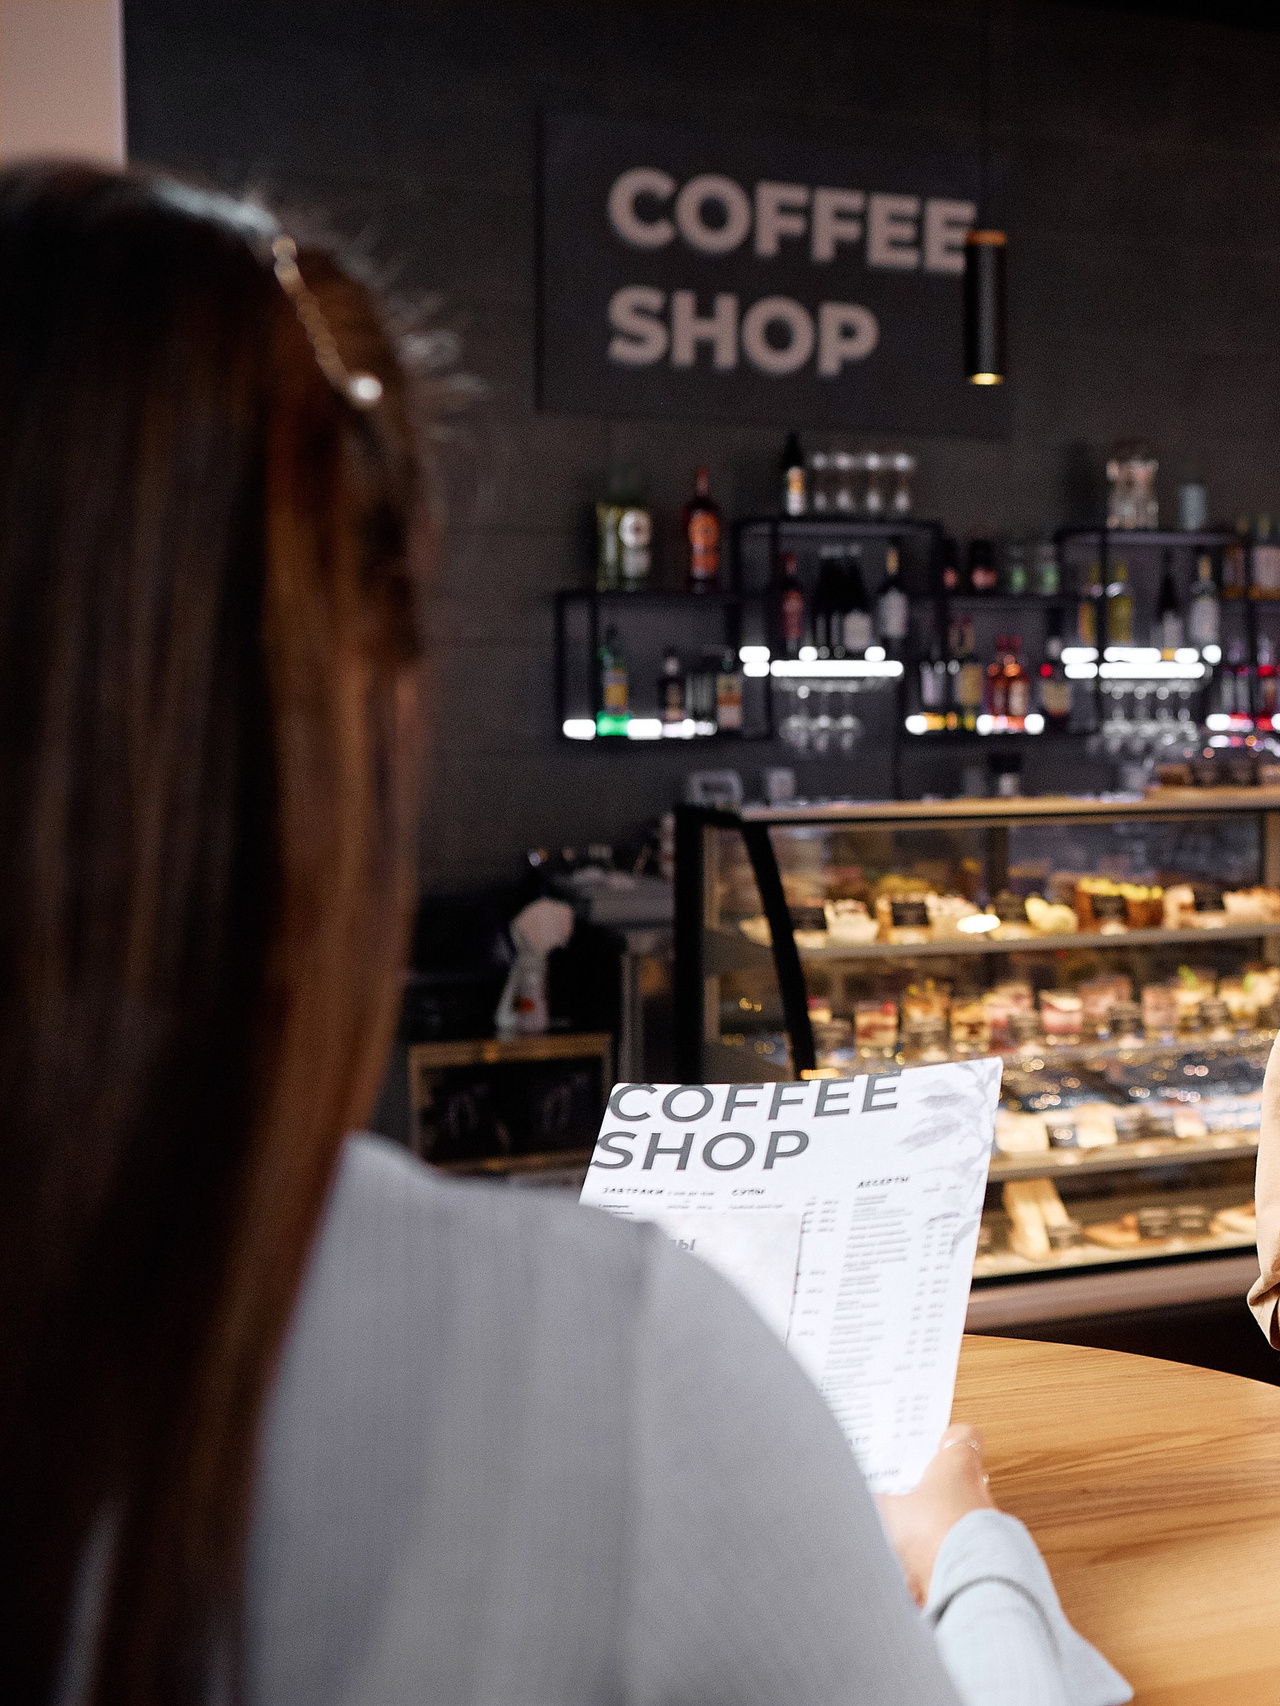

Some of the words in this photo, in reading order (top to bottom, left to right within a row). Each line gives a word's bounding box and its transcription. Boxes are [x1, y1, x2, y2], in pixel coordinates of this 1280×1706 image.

[607, 166, 978, 273] COFFEE
[607, 285, 879, 378] SHOP
[608, 1074, 900, 1123] COFFEE
[590, 1129, 810, 1172] SHOP
